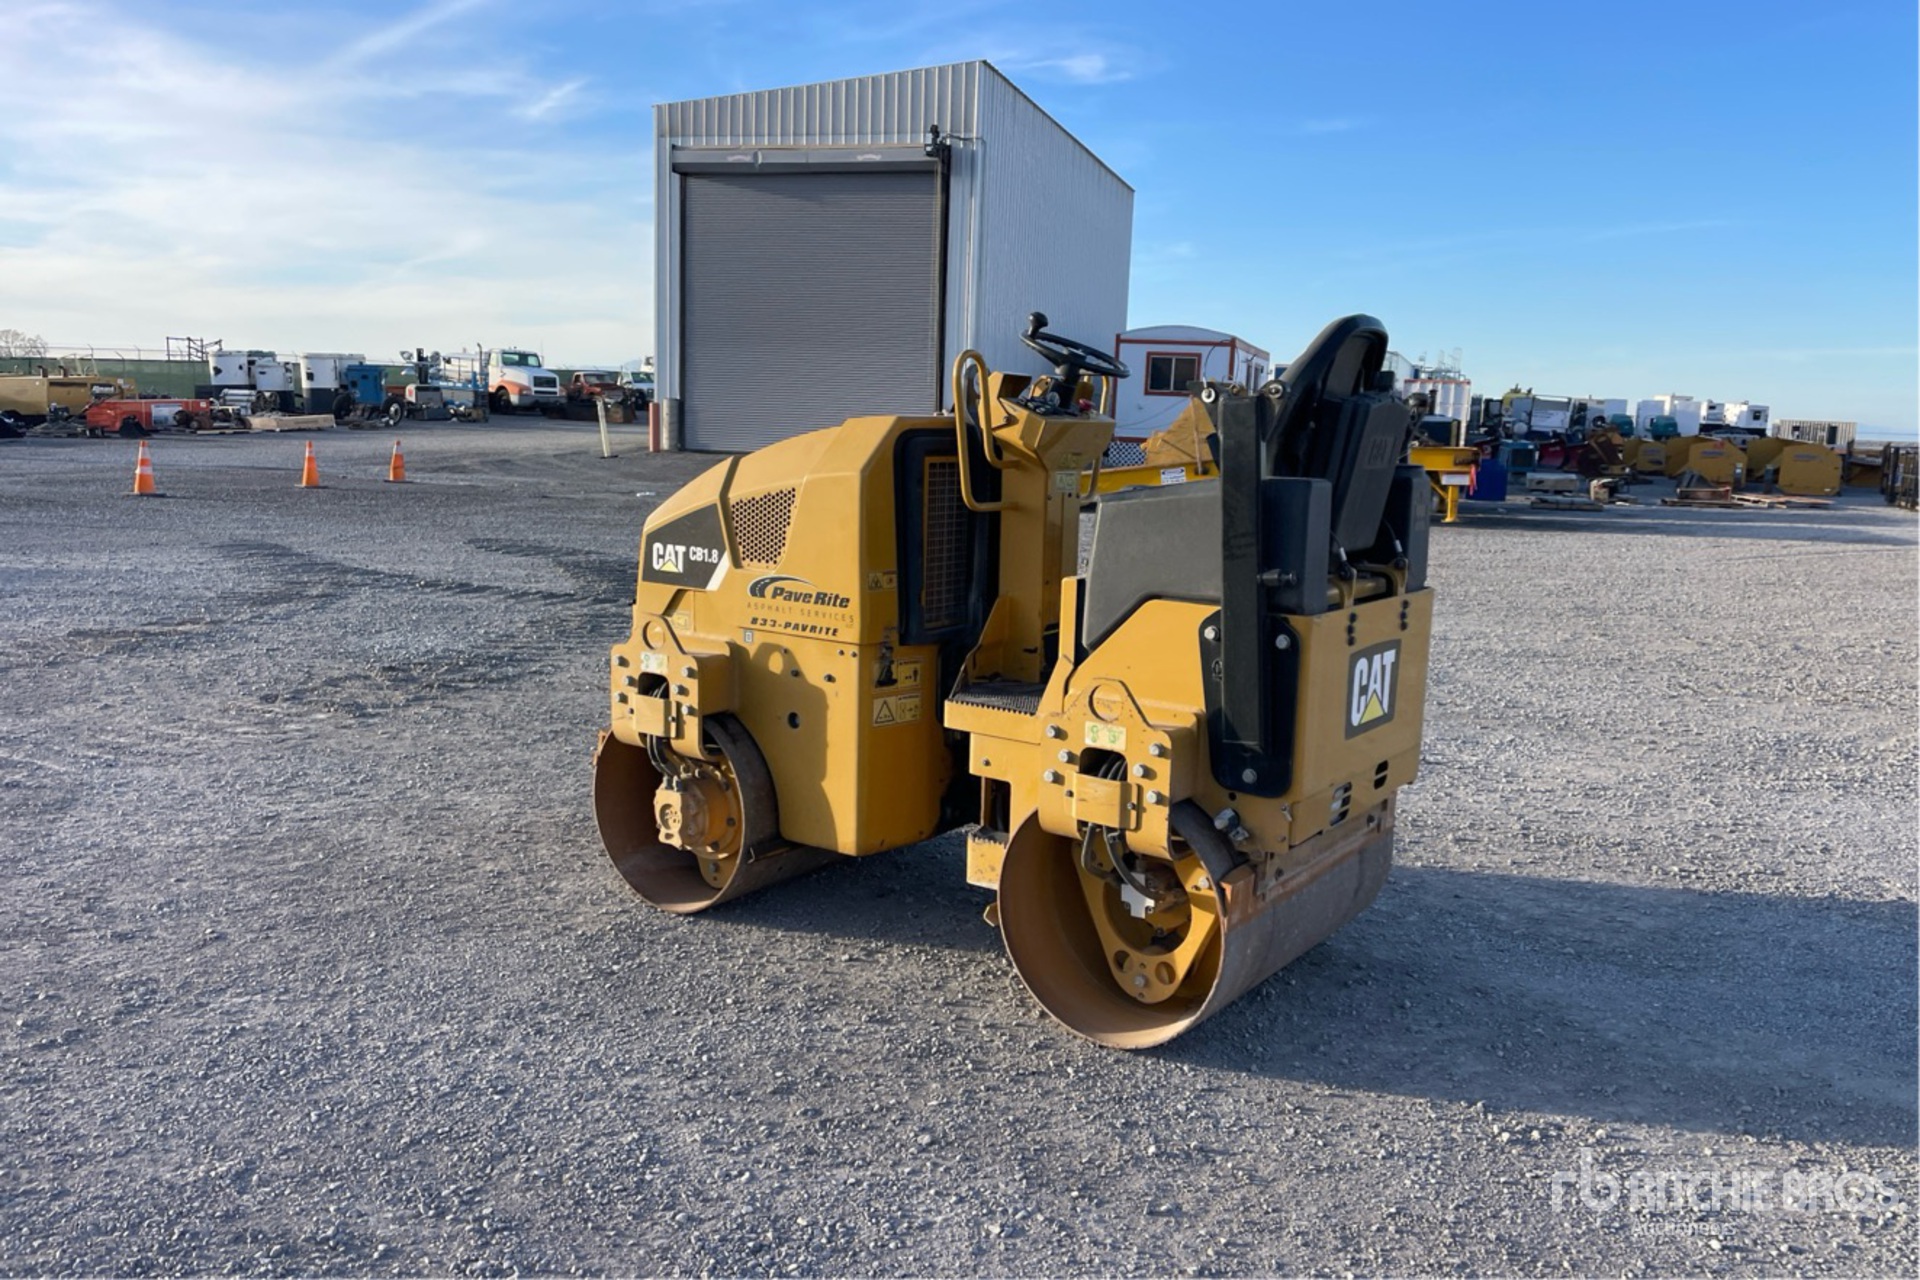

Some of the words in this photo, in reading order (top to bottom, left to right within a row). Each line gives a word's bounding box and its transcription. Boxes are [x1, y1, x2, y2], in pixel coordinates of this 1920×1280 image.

[652, 542, 687, 574] CAT
[688, 546, 719, 564] CB1.8
[747, 602, 792, 615] ASPHALT
[800, 608, 855, 623] SERVICES
[750, 616, 839, 637] 833-PAVRITE
[1350, 649, 1397, 727] CAT
